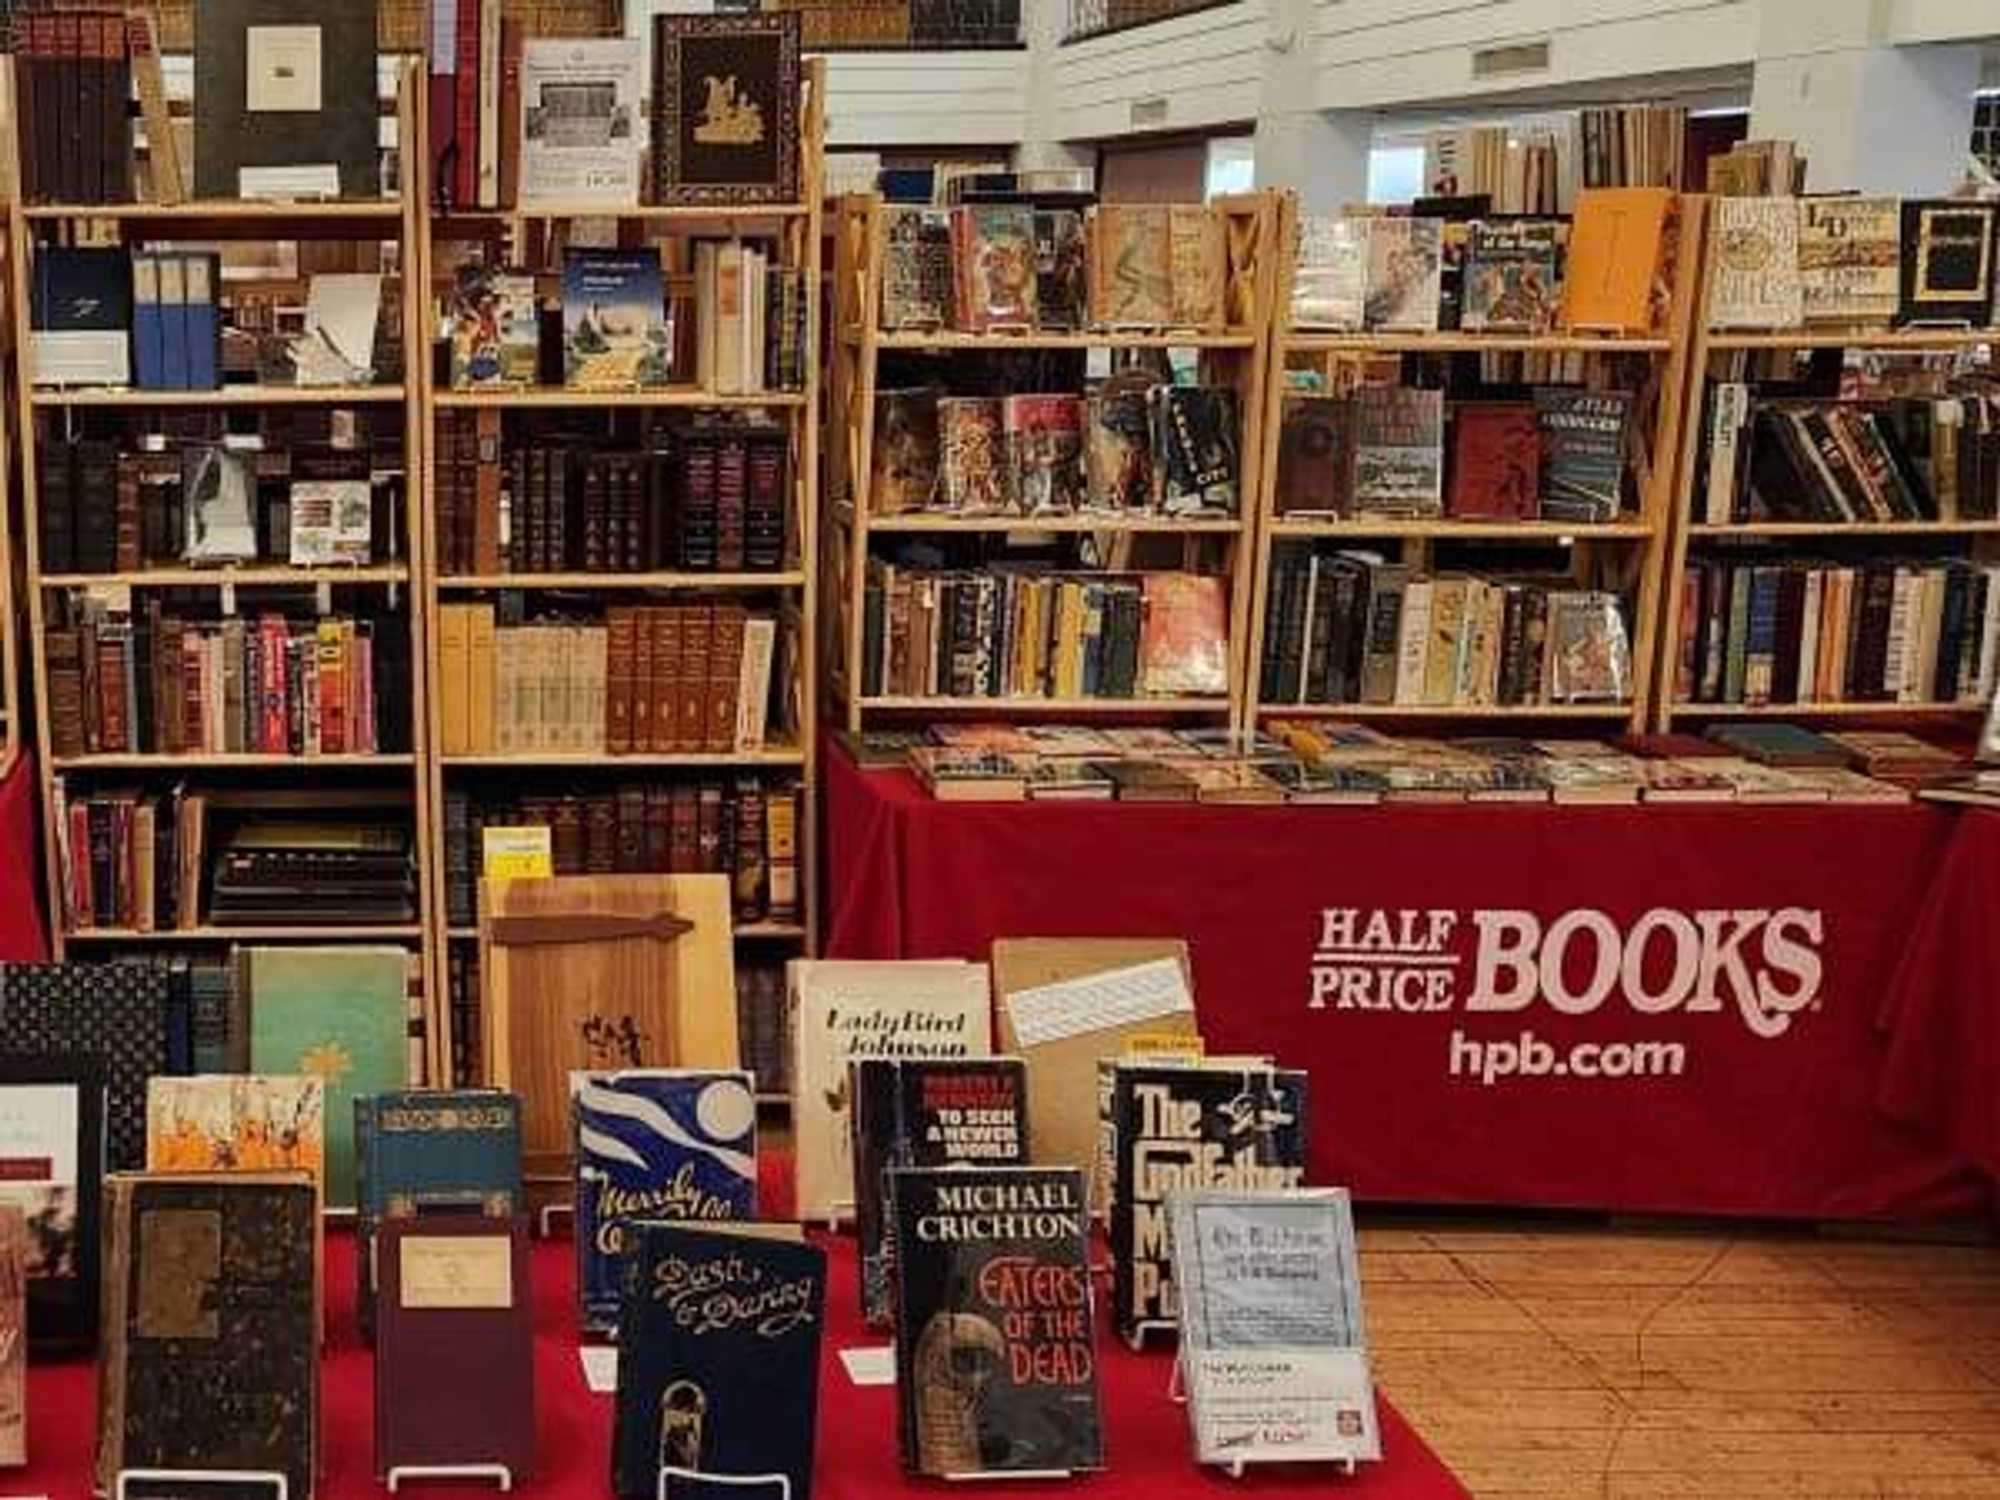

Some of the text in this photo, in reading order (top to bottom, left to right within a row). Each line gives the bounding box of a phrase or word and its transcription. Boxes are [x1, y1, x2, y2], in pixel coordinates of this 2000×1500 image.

[1318, 909, 1458, 951] HALF
[1309, 966, 1456, 1012] PRICE
[1466, 907, 1823, 1038] BOOKS
[1449, 1031, 1686, 1084] hpb.com
[936, 1110, 962, 1125] TO
[1133, 1083, 1202, 1138] The
[936, 1184, 1078, 1212] MICHAEL
[917, 1213, 1082, 1242] CRICHTON
[980, 1256, 1086, 1307] EATERS
[1004, 1309, 1087, 1339] OF THE
[1010, 1342, 1093, 1385] DEAD
